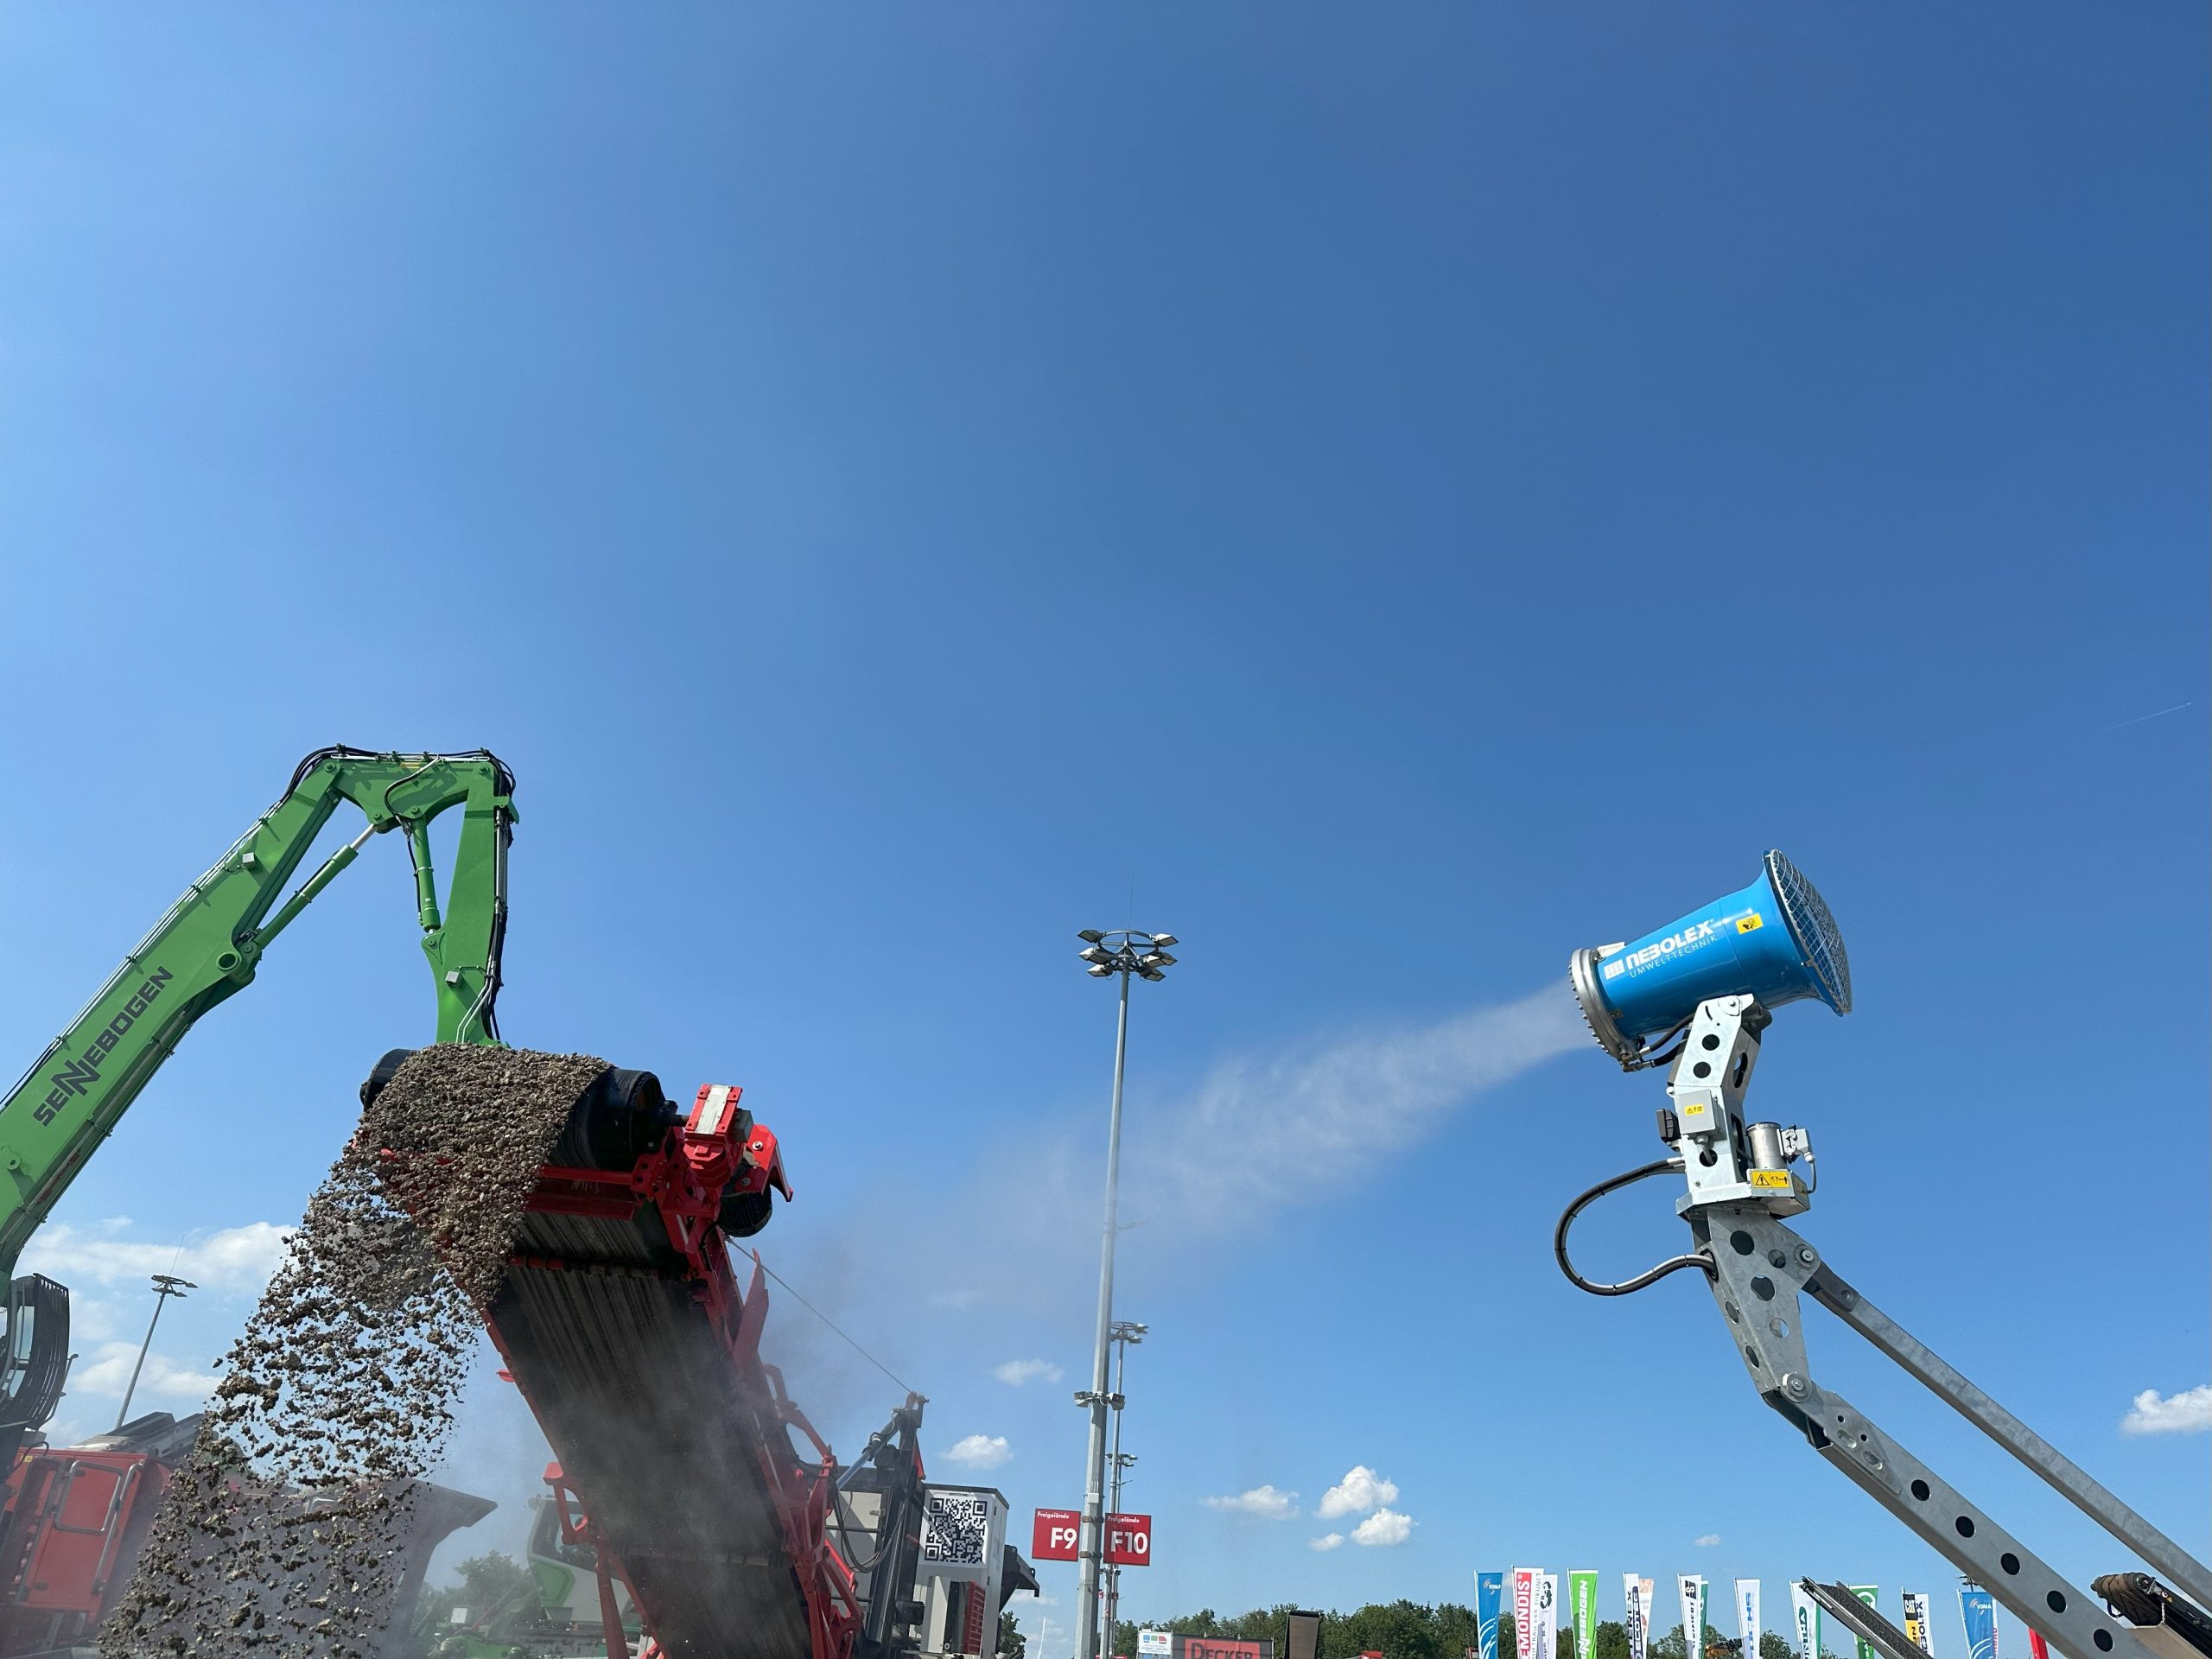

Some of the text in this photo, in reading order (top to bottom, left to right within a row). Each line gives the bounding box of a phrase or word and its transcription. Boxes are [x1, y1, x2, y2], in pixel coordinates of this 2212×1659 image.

[1625, 921, 1715, 969] NEBOLEX
[1629, 934, 1718, 978] UMWELTTECHNIK
[33, 965, 174, 1127] SENNEBOGEN
[1037, 1510, 1070, 1519] Freigelände
[1107, 1516, 1141, 1524] Freigelände
[1050, 1527, 1077, 1549] F9
[1110, 1530, 1148, 1554] F10
[1517, 1580, 1531, 1659] EMONDIS
[1578, 1580, 1590, 1659] ENNEBOGEN
[1914, 1601, 1928, 1652] EBOLEX
